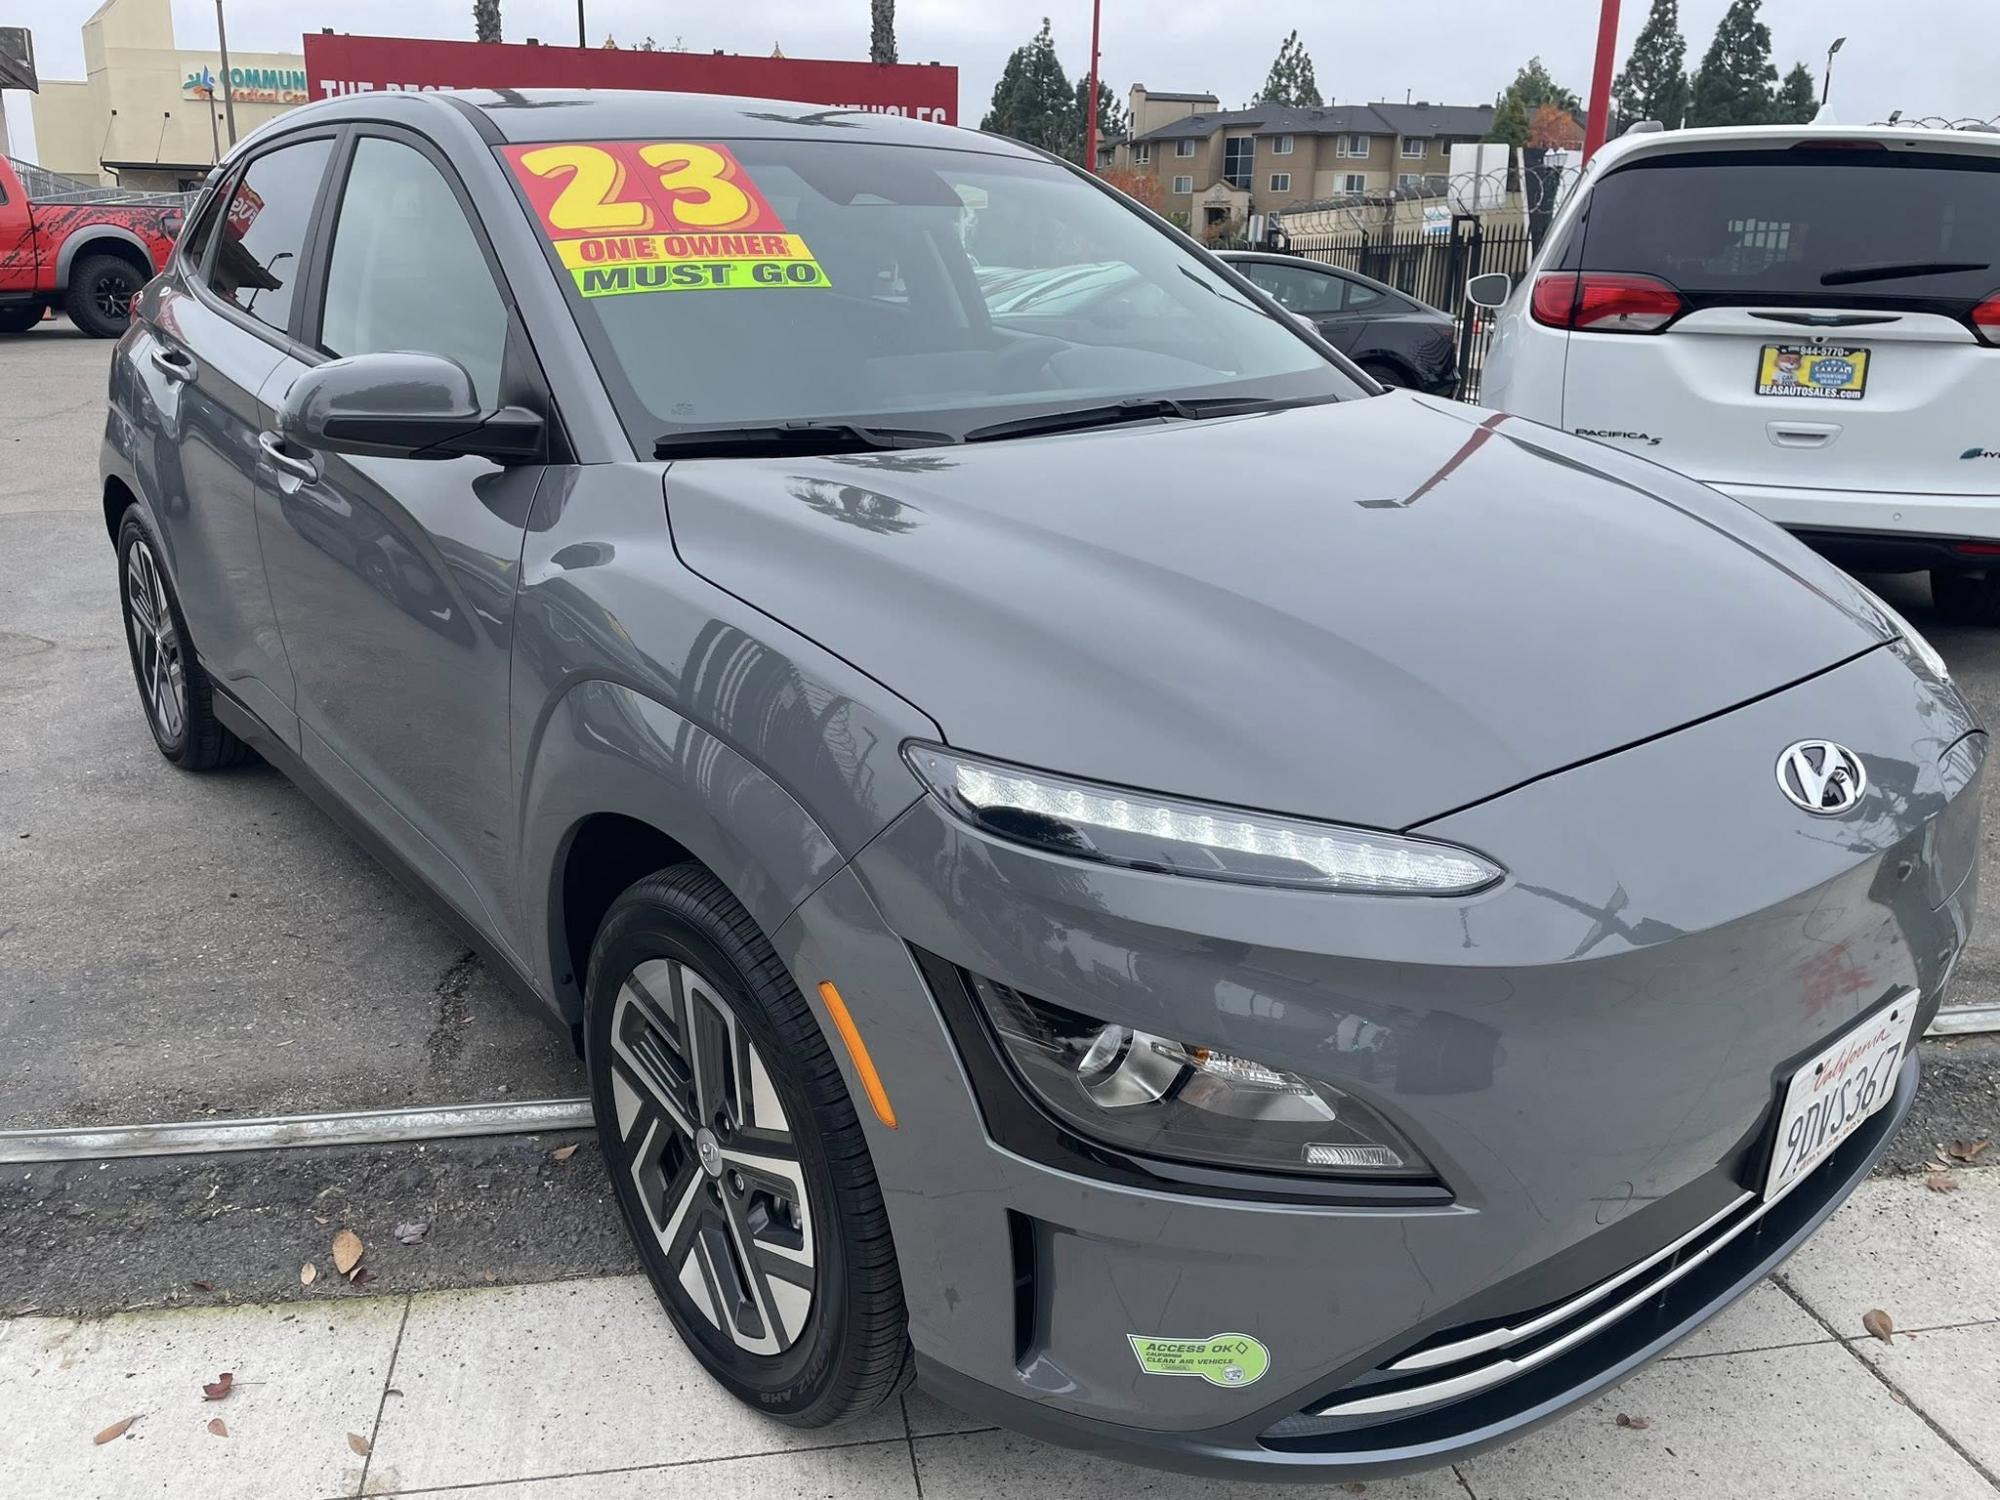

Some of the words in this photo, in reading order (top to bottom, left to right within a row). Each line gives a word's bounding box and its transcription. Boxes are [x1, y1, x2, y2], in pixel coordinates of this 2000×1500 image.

[520, 143, 757, 230] 23
[580, 236, 657, 262] ONE
[664, 234, 790, 259] OWNER
[583, 263, 735, 293] MUST
[753, 263, 818, 285] GO
[1759, 385, 1861, 399] BEASAUTOSALES.com
[1575, 428, 1649, 440] PACIFICA
[1647, 437, 1663, 446] S
[1977, 451, 2000, 459] HY
[1812, 1026, 1891, 1091] California
[1780, 1042, 1902, 1178] 9DVS367
[1146, 1343, 1206, 1353] ACCESS
[1211, 1344, 1234, 1353] OK
